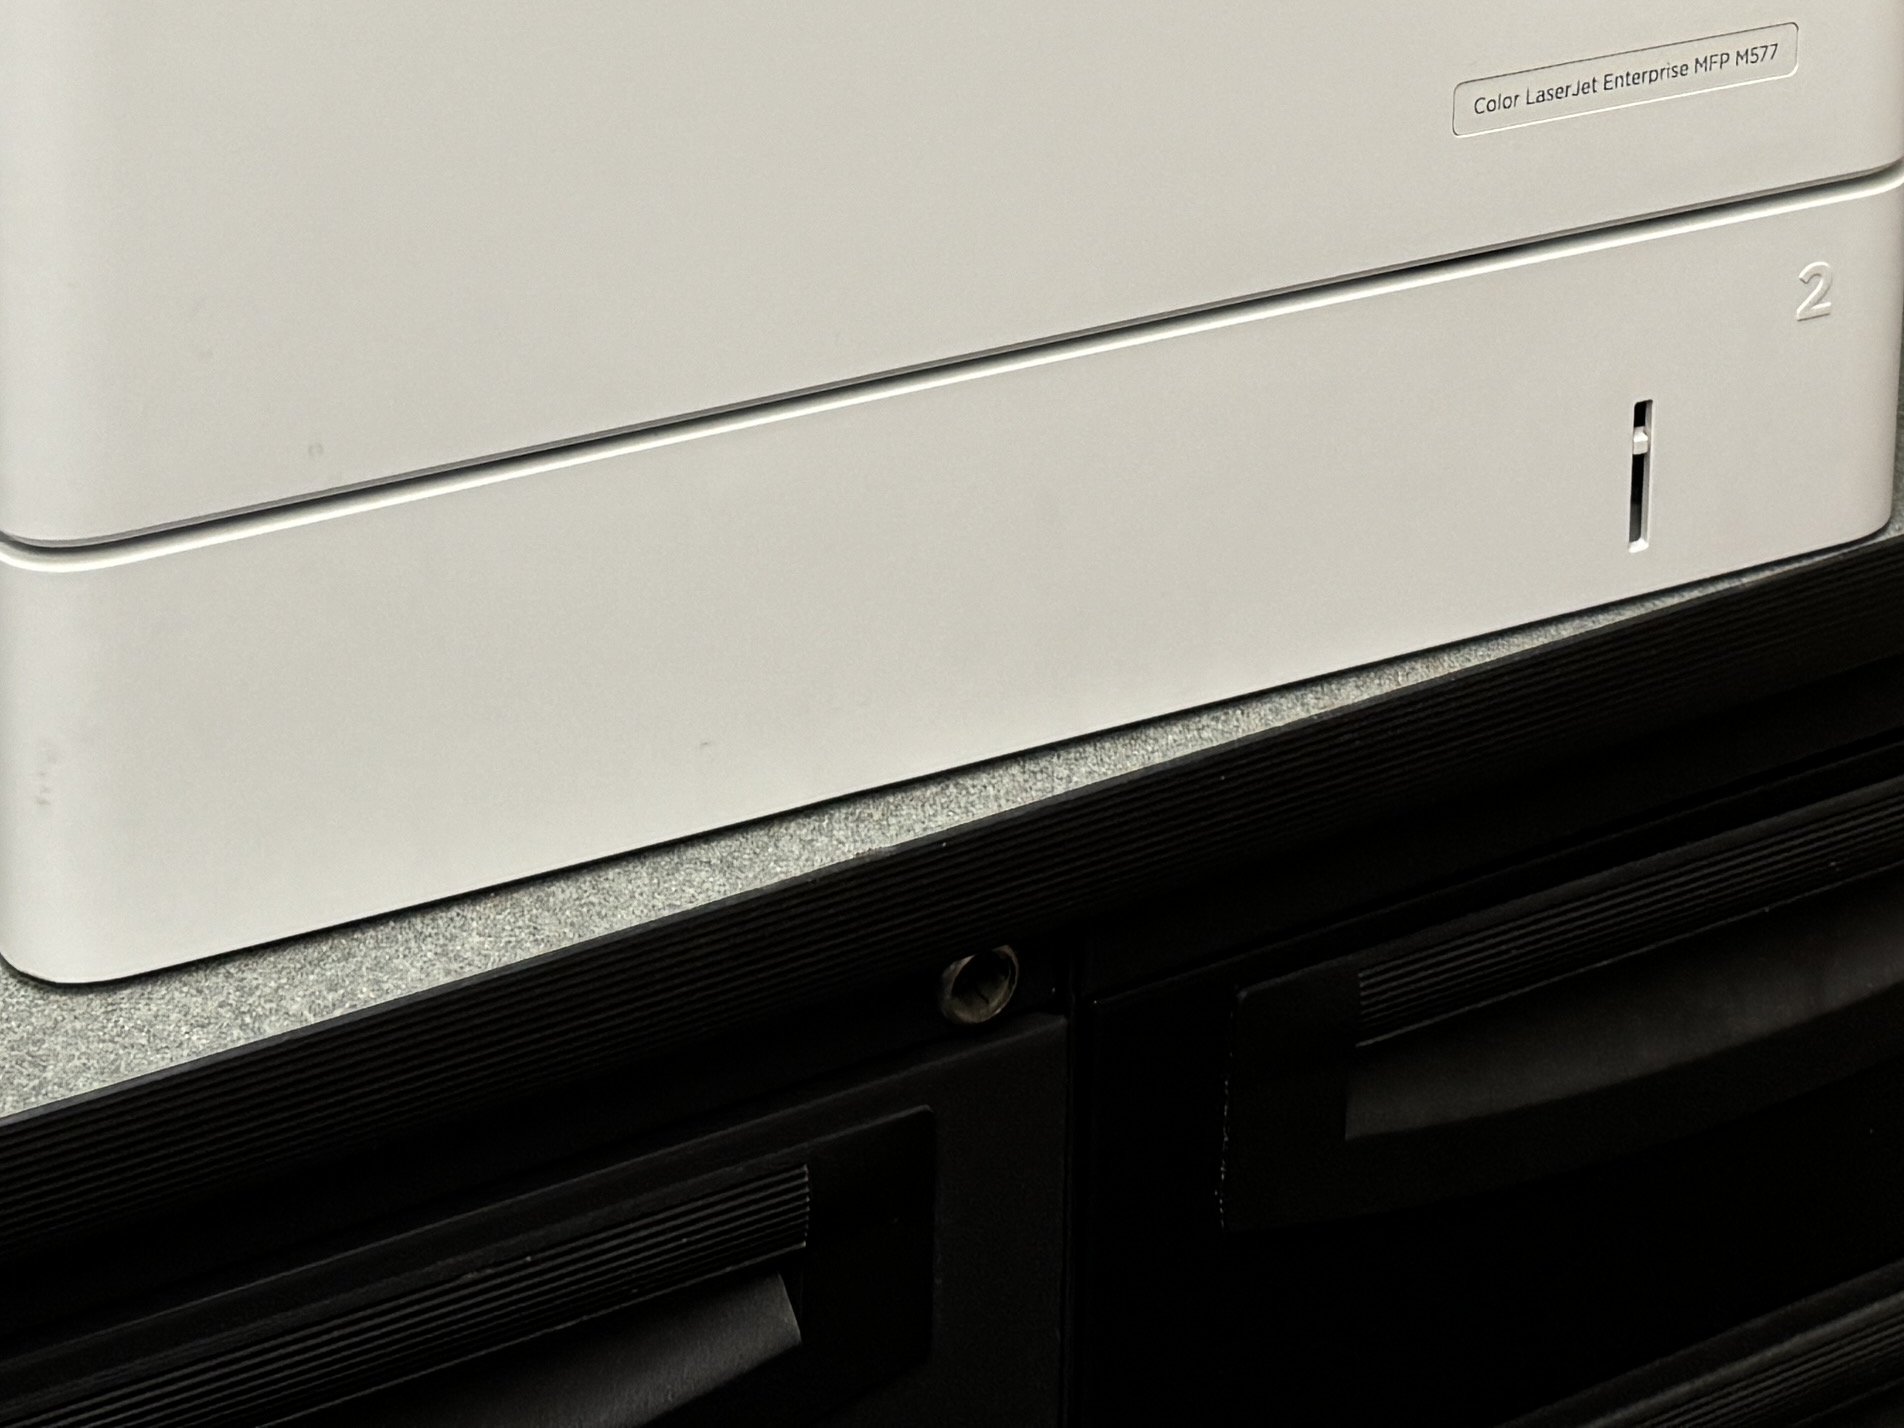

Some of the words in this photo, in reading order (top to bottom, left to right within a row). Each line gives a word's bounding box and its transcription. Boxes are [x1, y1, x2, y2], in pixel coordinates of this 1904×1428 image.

[1473, 93, 1521, 116] Color
[1525, 77, 1599, 106] LaserJet
[1603, 61, 1689, 92] Enterprise
[1694, 52, 1731, 74] MFP
[1735, 43, 1780, 68] M577
[1795, 261, 1834, 322] 2
